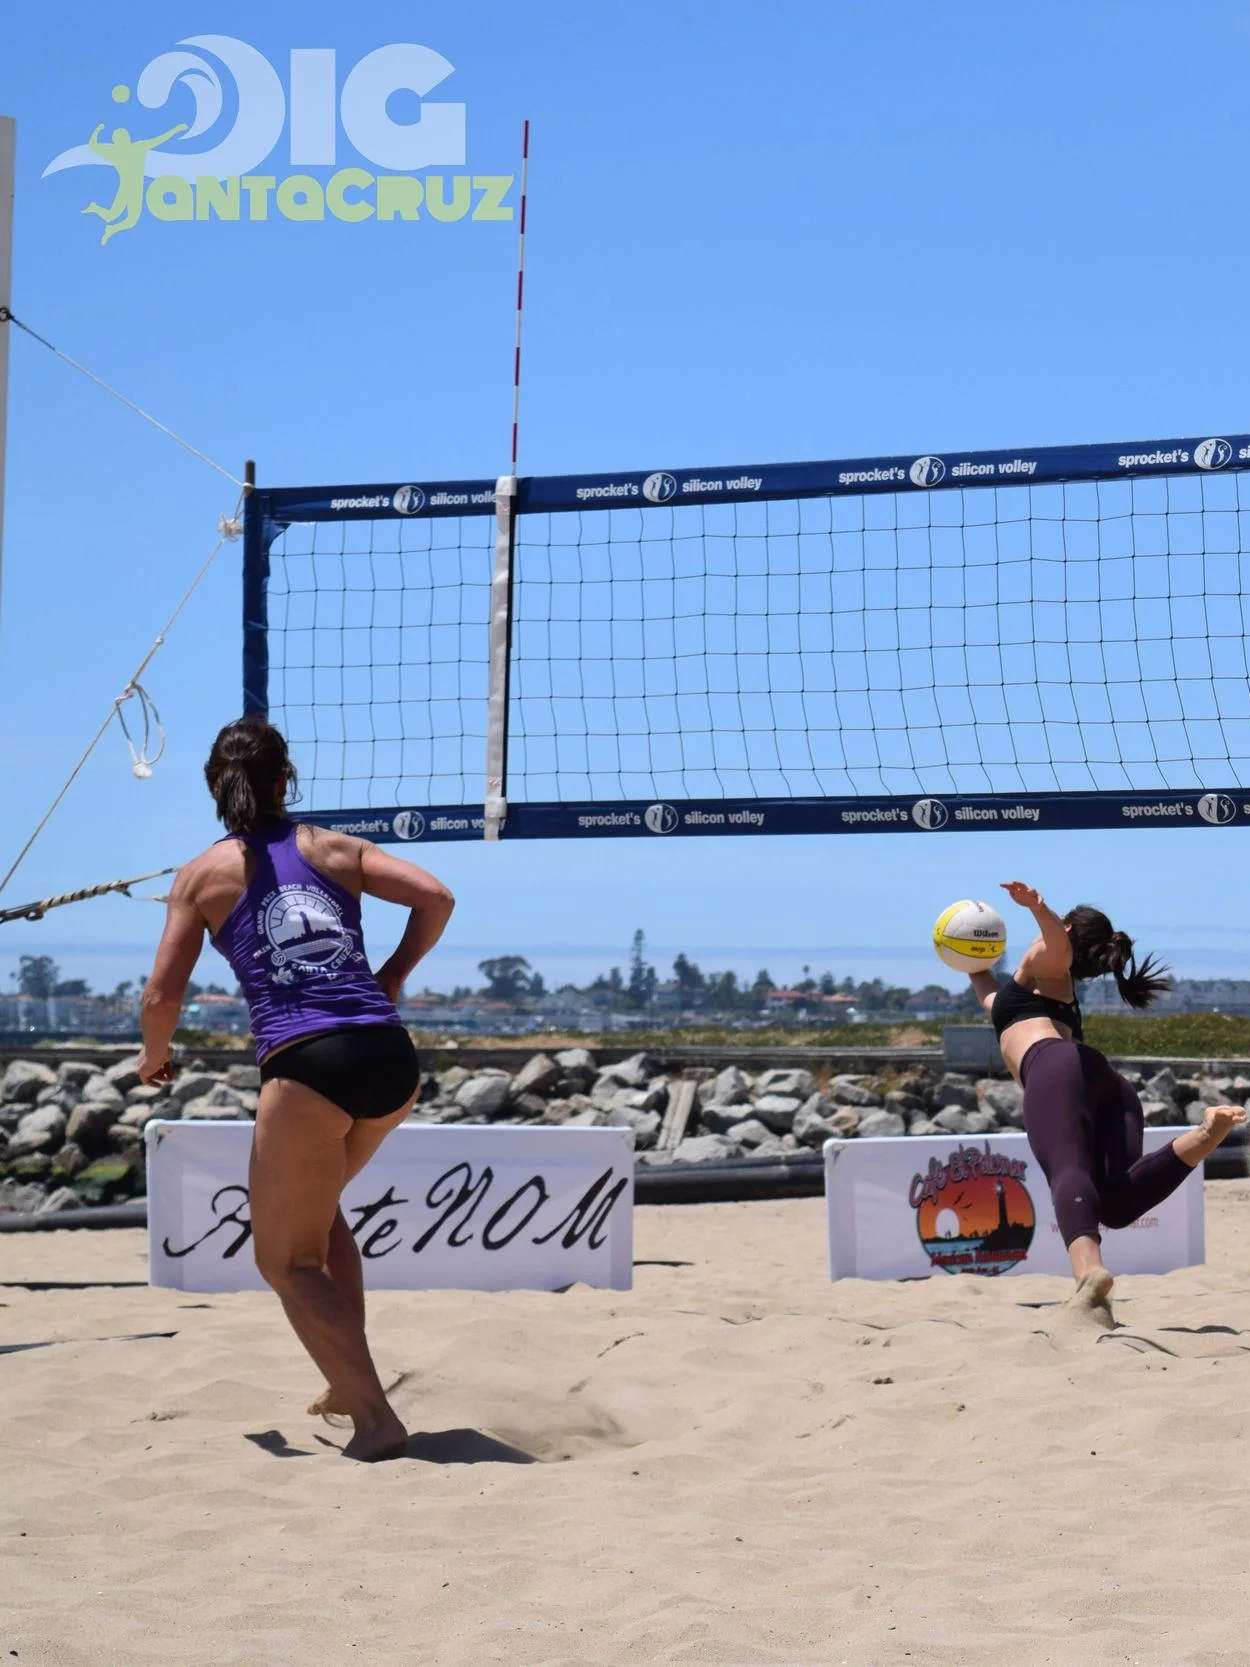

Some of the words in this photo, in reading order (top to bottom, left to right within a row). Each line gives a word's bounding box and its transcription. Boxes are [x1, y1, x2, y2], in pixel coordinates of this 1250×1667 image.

[1118, 449, 1189, 468] sprocket's
[839, 467, 905, 485] sprocket's
[952, 463, 994, 476] silicon
[999, 460, 1037, 474] volley
[577, 483, 638, 500] sprocket's
[682, 479, 724, 493] silicon
[728, 477, 763, 491] volley
[331, 496, 389, 510] sprocket's
[430, 493, 468, 505] silicon
[578, 813, 640, 828] sprocket's
[685, 811, 724, 824] silicon
[728, 811, 764, 825] volley
[842, 808, 908, 824] sprocket's
[955, 807, 998, 820] silicon
[1001, 806, 1039, 821] volley
[1122, 803, 1193, 818] sprocket's
[331, 820, 389, 834] sprocket's
[431, 817, 468, 830] silicon
[331, 946, 351, 970] CRUZ
